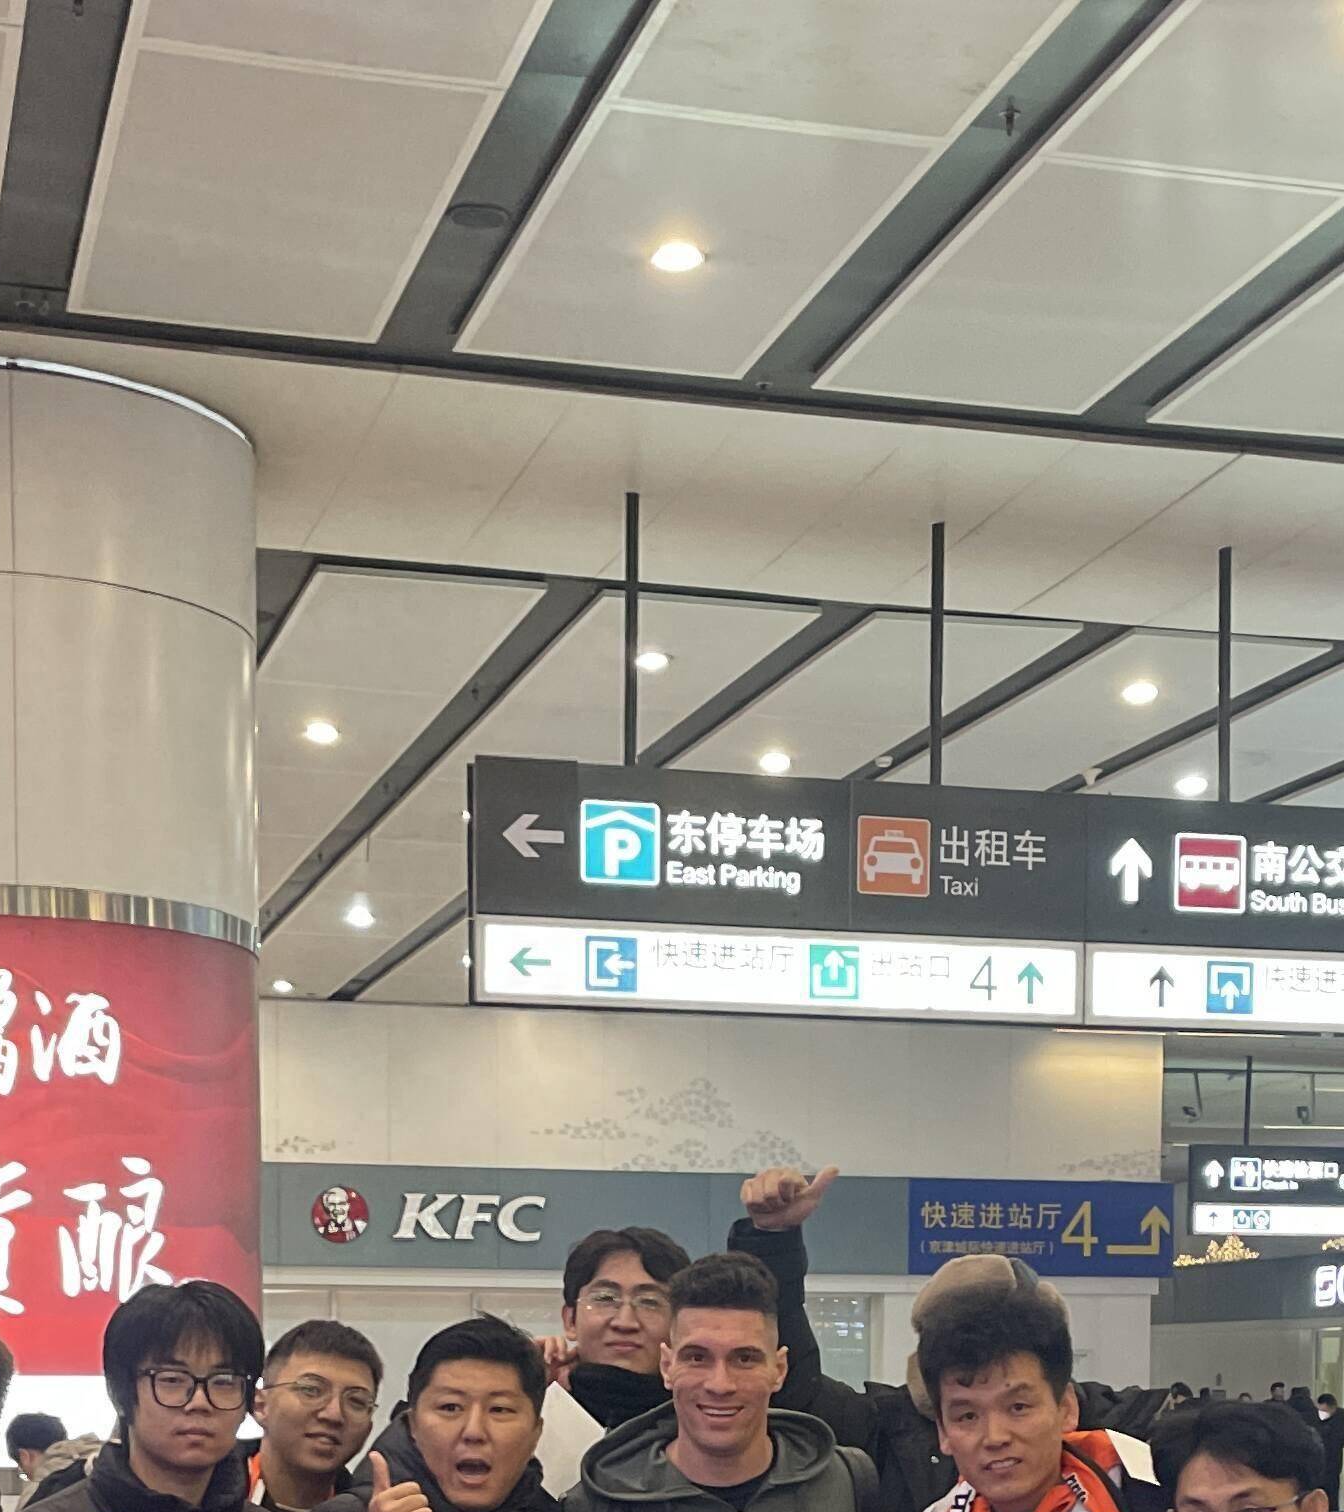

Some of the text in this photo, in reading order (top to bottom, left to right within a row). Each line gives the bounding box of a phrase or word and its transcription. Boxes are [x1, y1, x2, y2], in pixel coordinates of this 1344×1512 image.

[667, 811, 824, 861] 东停车场
[939, 826, 1046, 870] 出租车
[667, 862, 801, 895] East Parking
[941, 875, 978, 896] Taxi
[1250, 891, 1310, 915] South
[970, 957, 997, 1000] 4
[392, 1192, 546, 1243] KFC
[921, 1201, 1098, 1257] 快速进站厅 4
